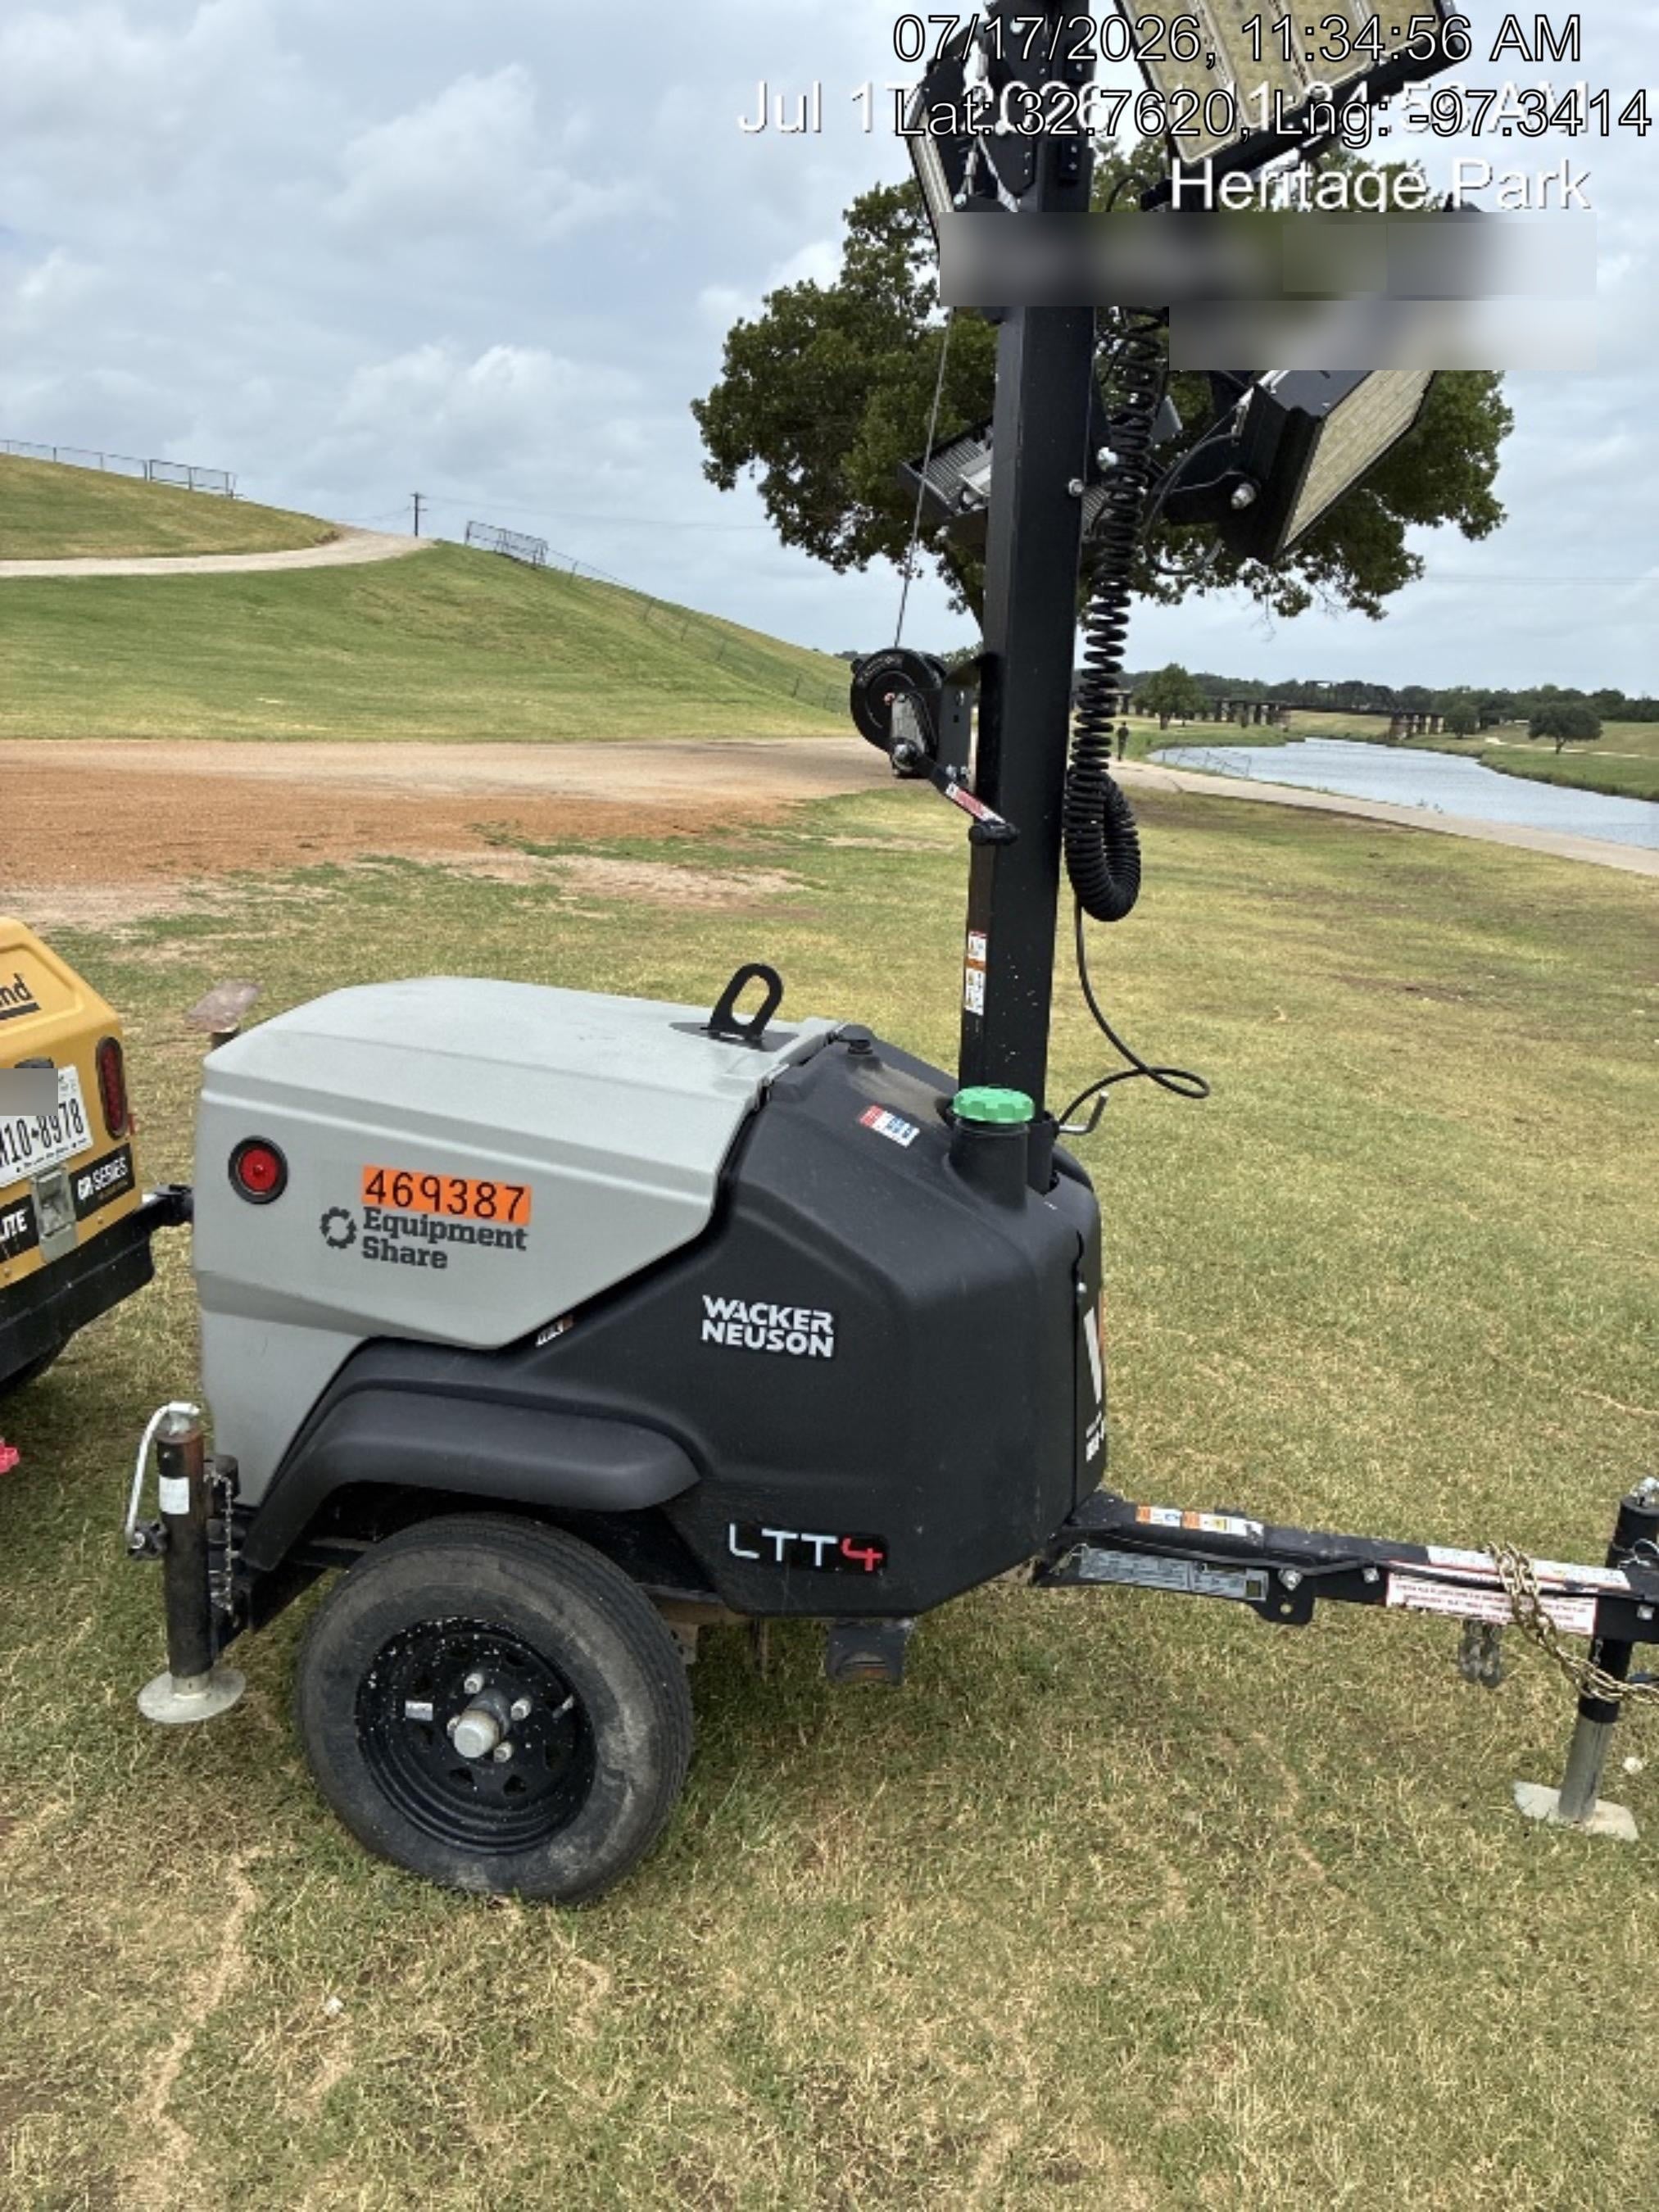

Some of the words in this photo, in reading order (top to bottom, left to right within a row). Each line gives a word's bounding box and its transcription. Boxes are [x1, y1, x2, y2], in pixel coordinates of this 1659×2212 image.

[0, 972, 33, 1007] nd
[365, 1169, 525, 1222] 469387
[0, 1208, 29, 1241] ITE
[363, 1206, 527, 1251] Equipment
[362, 1235, 448, 1269] Share
[702, 1294, 834, 1335] WACKER
[701, 1318, 834, 1358] NEUSON
[729, 1524, 883, 1571] LTT4
